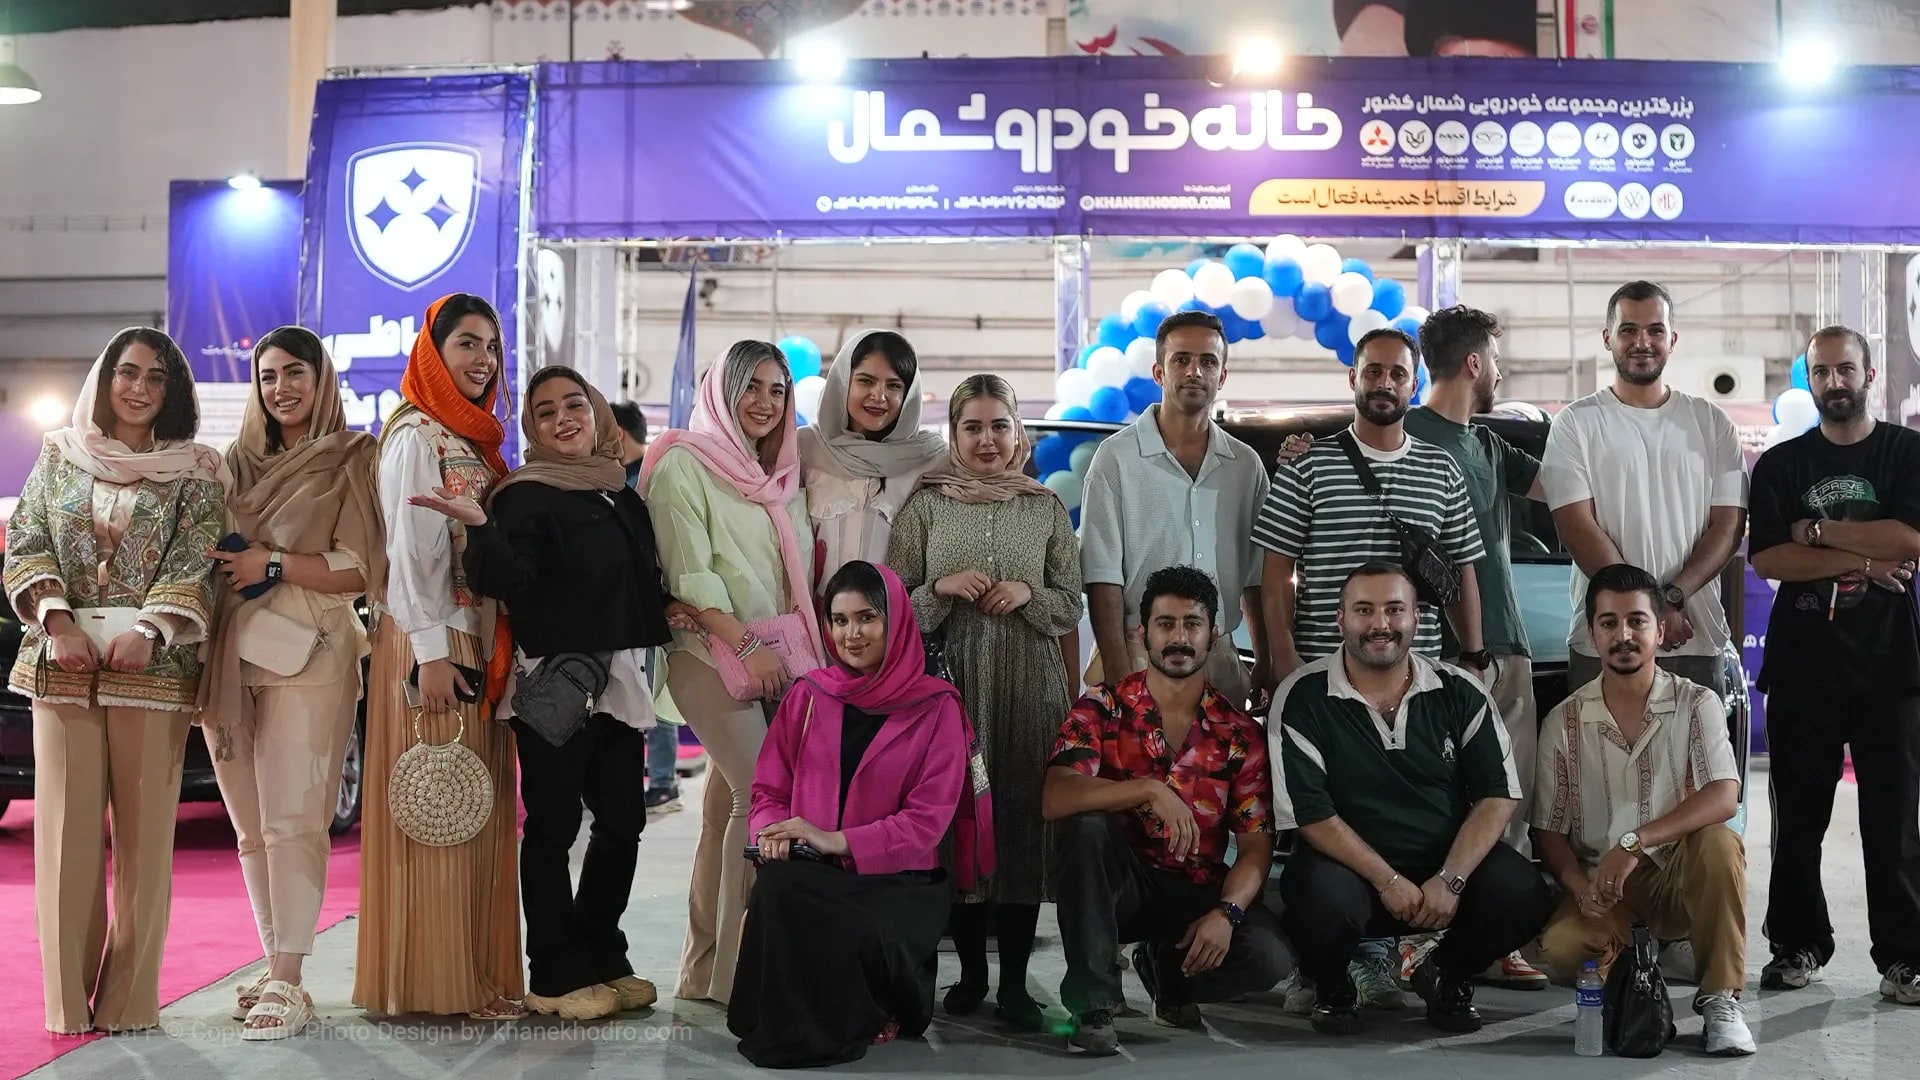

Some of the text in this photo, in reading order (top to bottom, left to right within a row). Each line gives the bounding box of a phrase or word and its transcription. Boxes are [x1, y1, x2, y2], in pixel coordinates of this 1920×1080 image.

[1361, 93, 1694, 119] بزرگترین مجموعه خودرویی شمال کشور
[827, 90, 1343, 173] خانه خودرو شمال
[1277, 186, 1517, 211] شرایط اقساط همیشه فعال است
